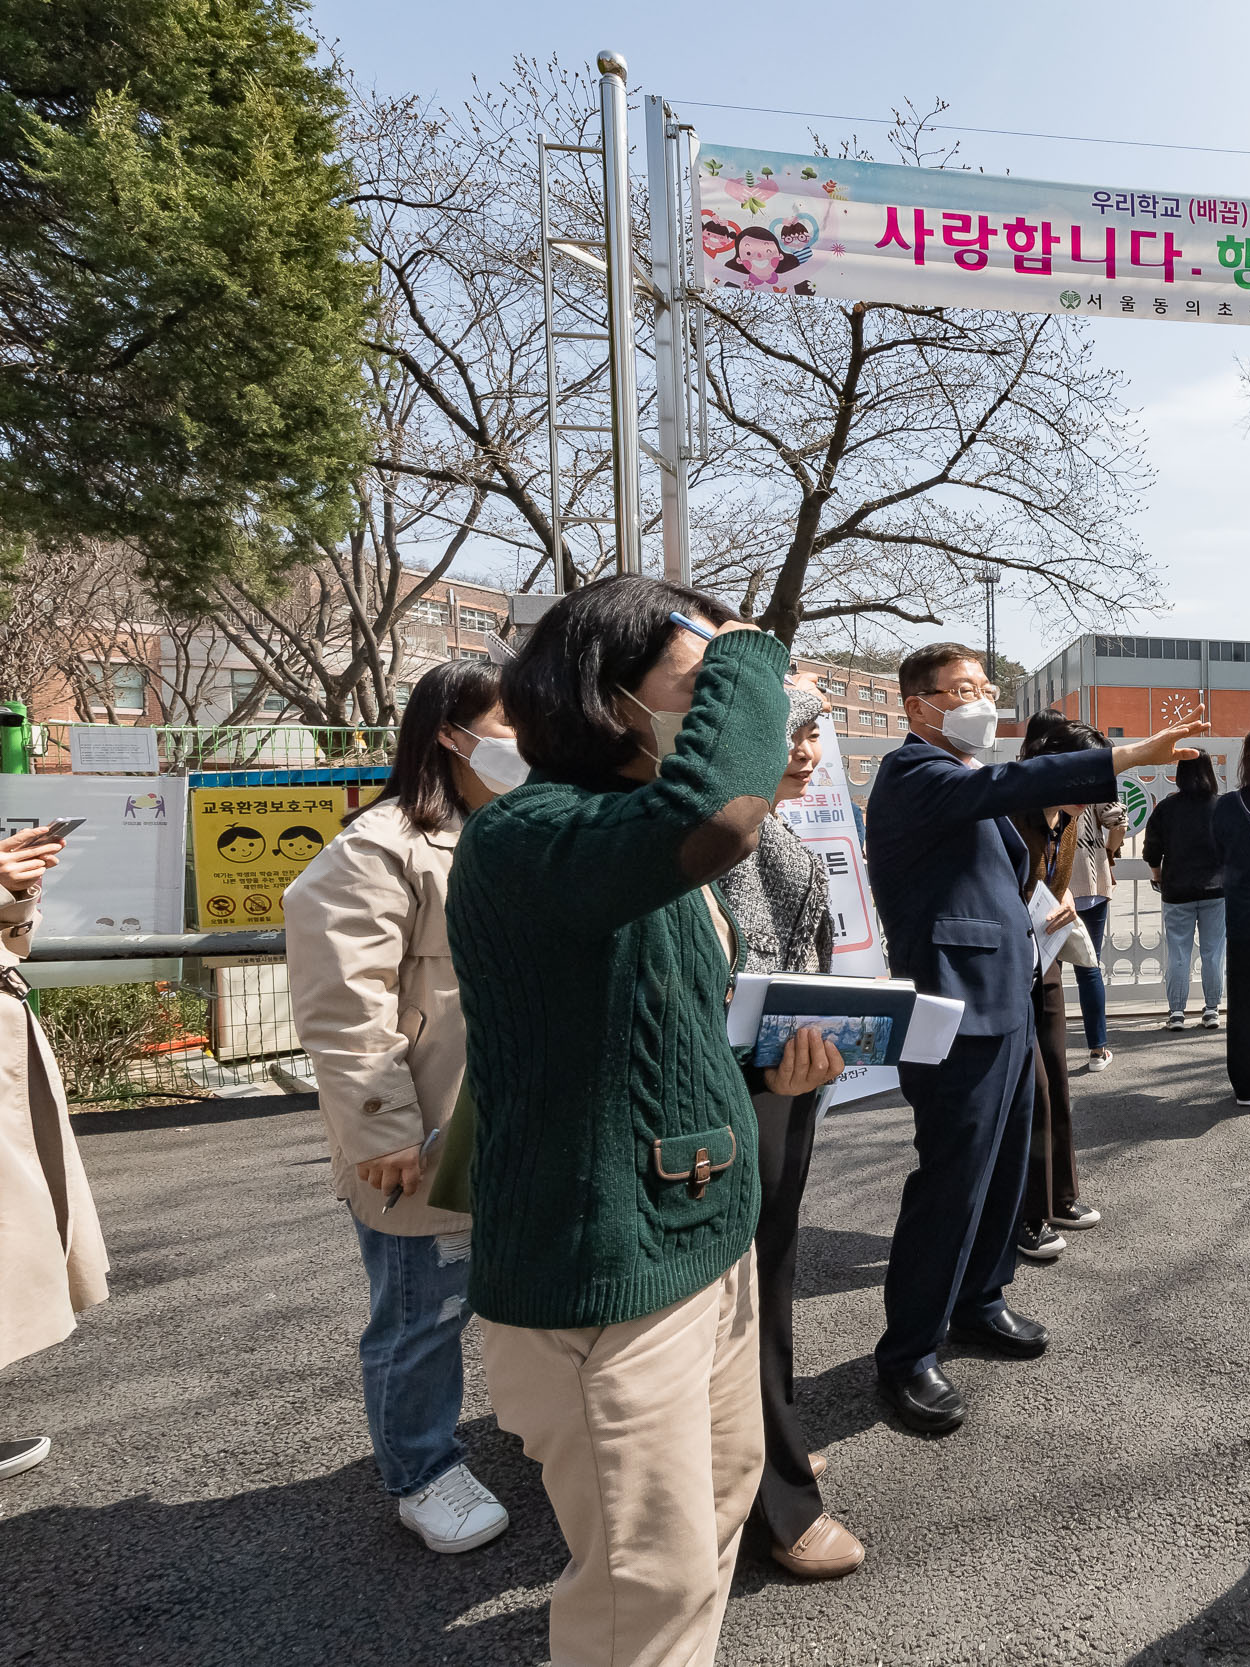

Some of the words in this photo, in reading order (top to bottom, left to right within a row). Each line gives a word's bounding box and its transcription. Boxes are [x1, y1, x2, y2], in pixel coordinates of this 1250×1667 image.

[1091, 190, 1183, 219] 우리학교
[1188, 197, 1249, 228] (배꼽)
[874, 205, 1202, 283] 사랑합니다.
[201, 799, 334, 815] 교육환경보호구역
[806, 809, 845, 823] 나들이
